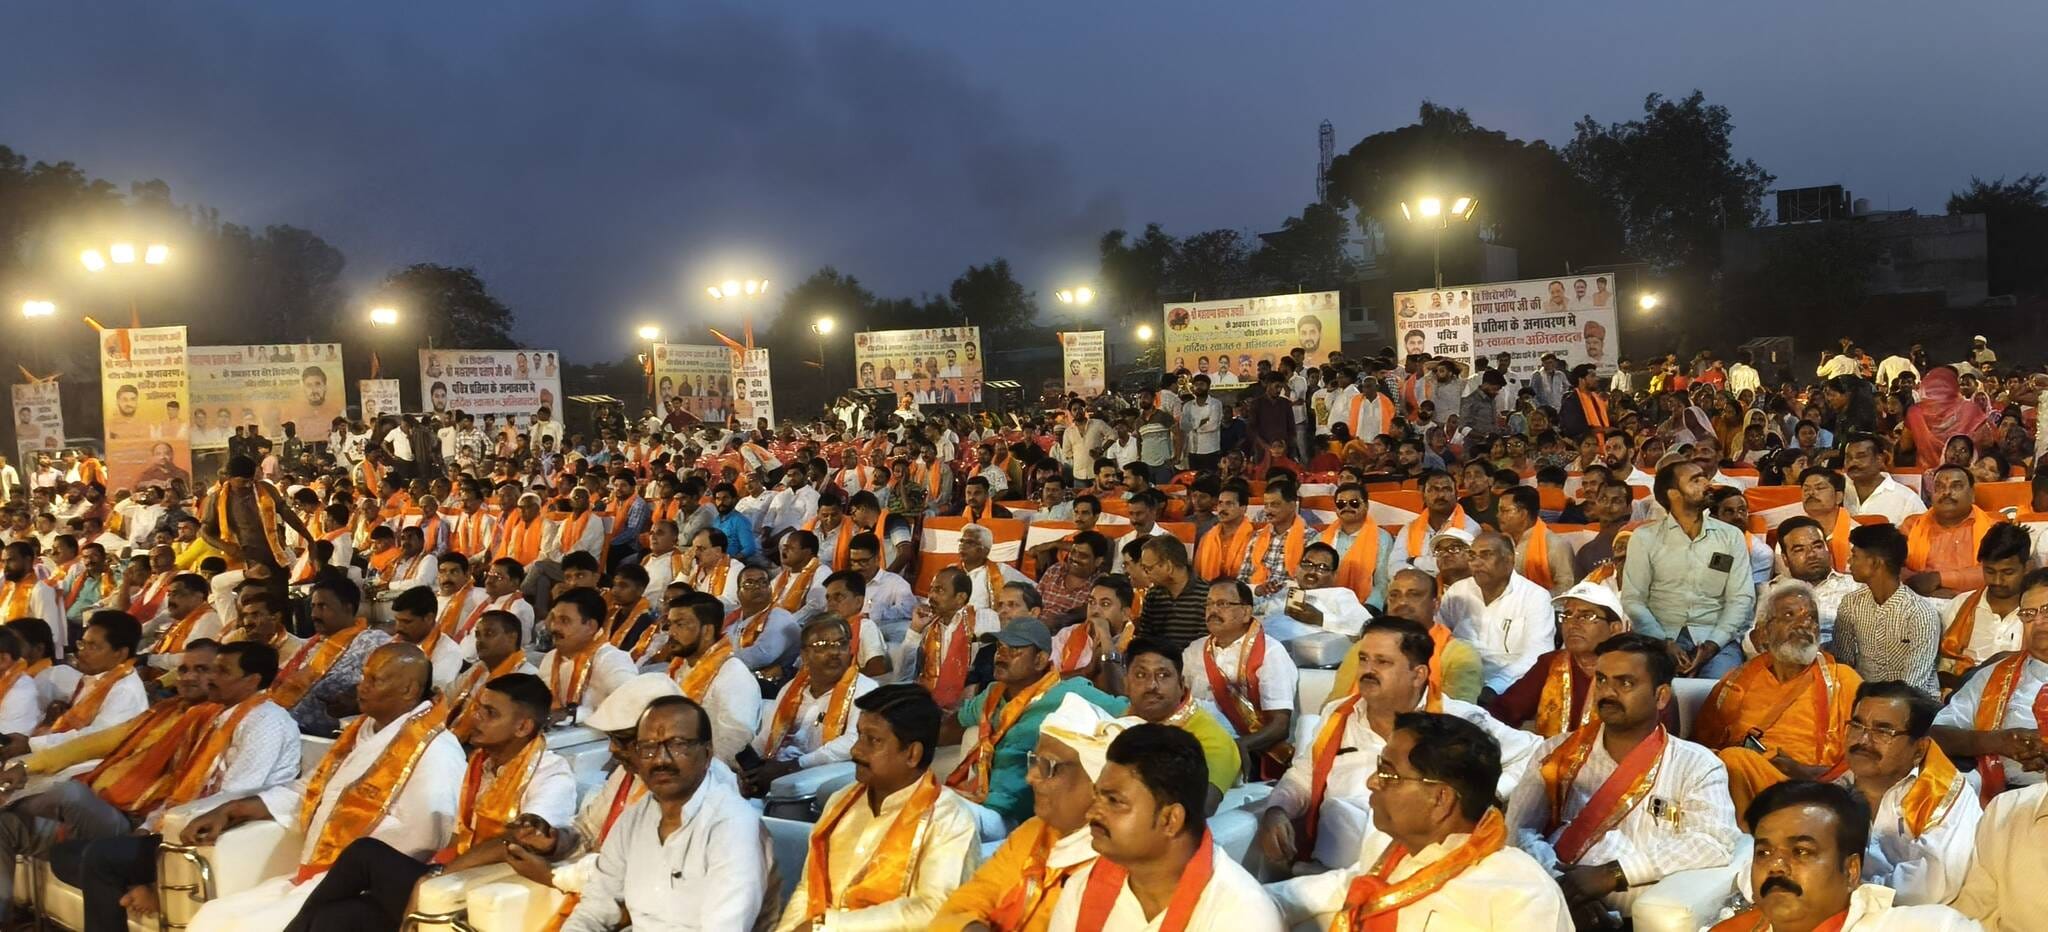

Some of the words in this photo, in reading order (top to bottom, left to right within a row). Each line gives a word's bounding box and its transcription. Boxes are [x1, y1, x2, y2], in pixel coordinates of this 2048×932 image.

[1494, 302, 1516, 313] प्रताप
[1517, 297, 1528, 311] जी
[1530, 297, 1541, 310] की
[1481, 318, 1508, 333] प्रतिमा
[1510, 317, 1519, 331] के
[1523, 316, 1566, 330] अनावरण
[1437, 329, 1458, 340] पवित्र
[1433, 343, 1459, 355] प्रतिमा
[1460, 341, 1469, 353] के
